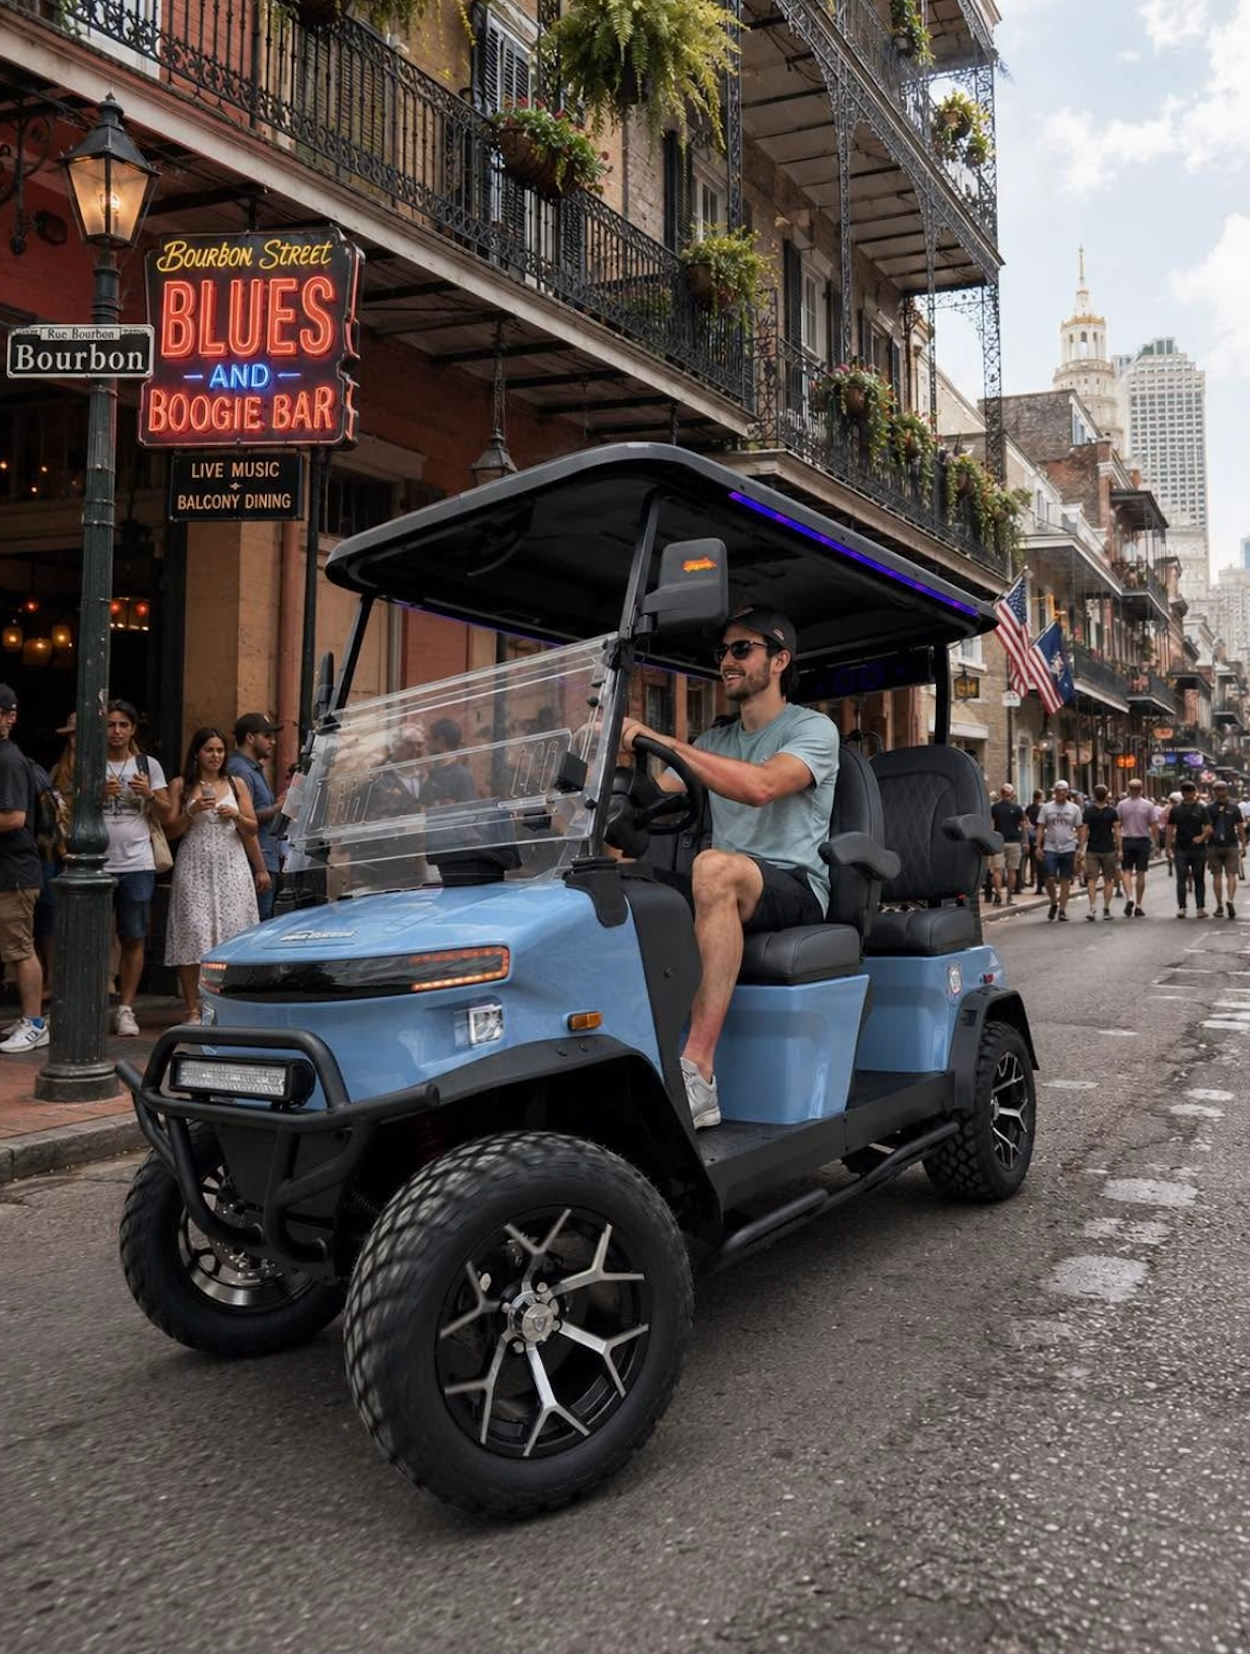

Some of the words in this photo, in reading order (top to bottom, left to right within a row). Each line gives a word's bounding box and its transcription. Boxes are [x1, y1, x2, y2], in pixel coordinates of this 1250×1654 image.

[160, 275, 337, 357] BLUES
[47, 329, 67, 339] Rue
[72, 328, 115, 339] Bourbon
[14, 344, 144, 370] Bourbon
[208, 363, 271, 389] AND
[148, 389, 264, 432] BOOGIE
[271, 386, 334, 430] BAR
[191, 462, 224, 478] LIVE
[231, 461, 280, 478] MUSIC
[177, 494, 240, 510] BALCONY
[245, 493, 292, 509] DINING
